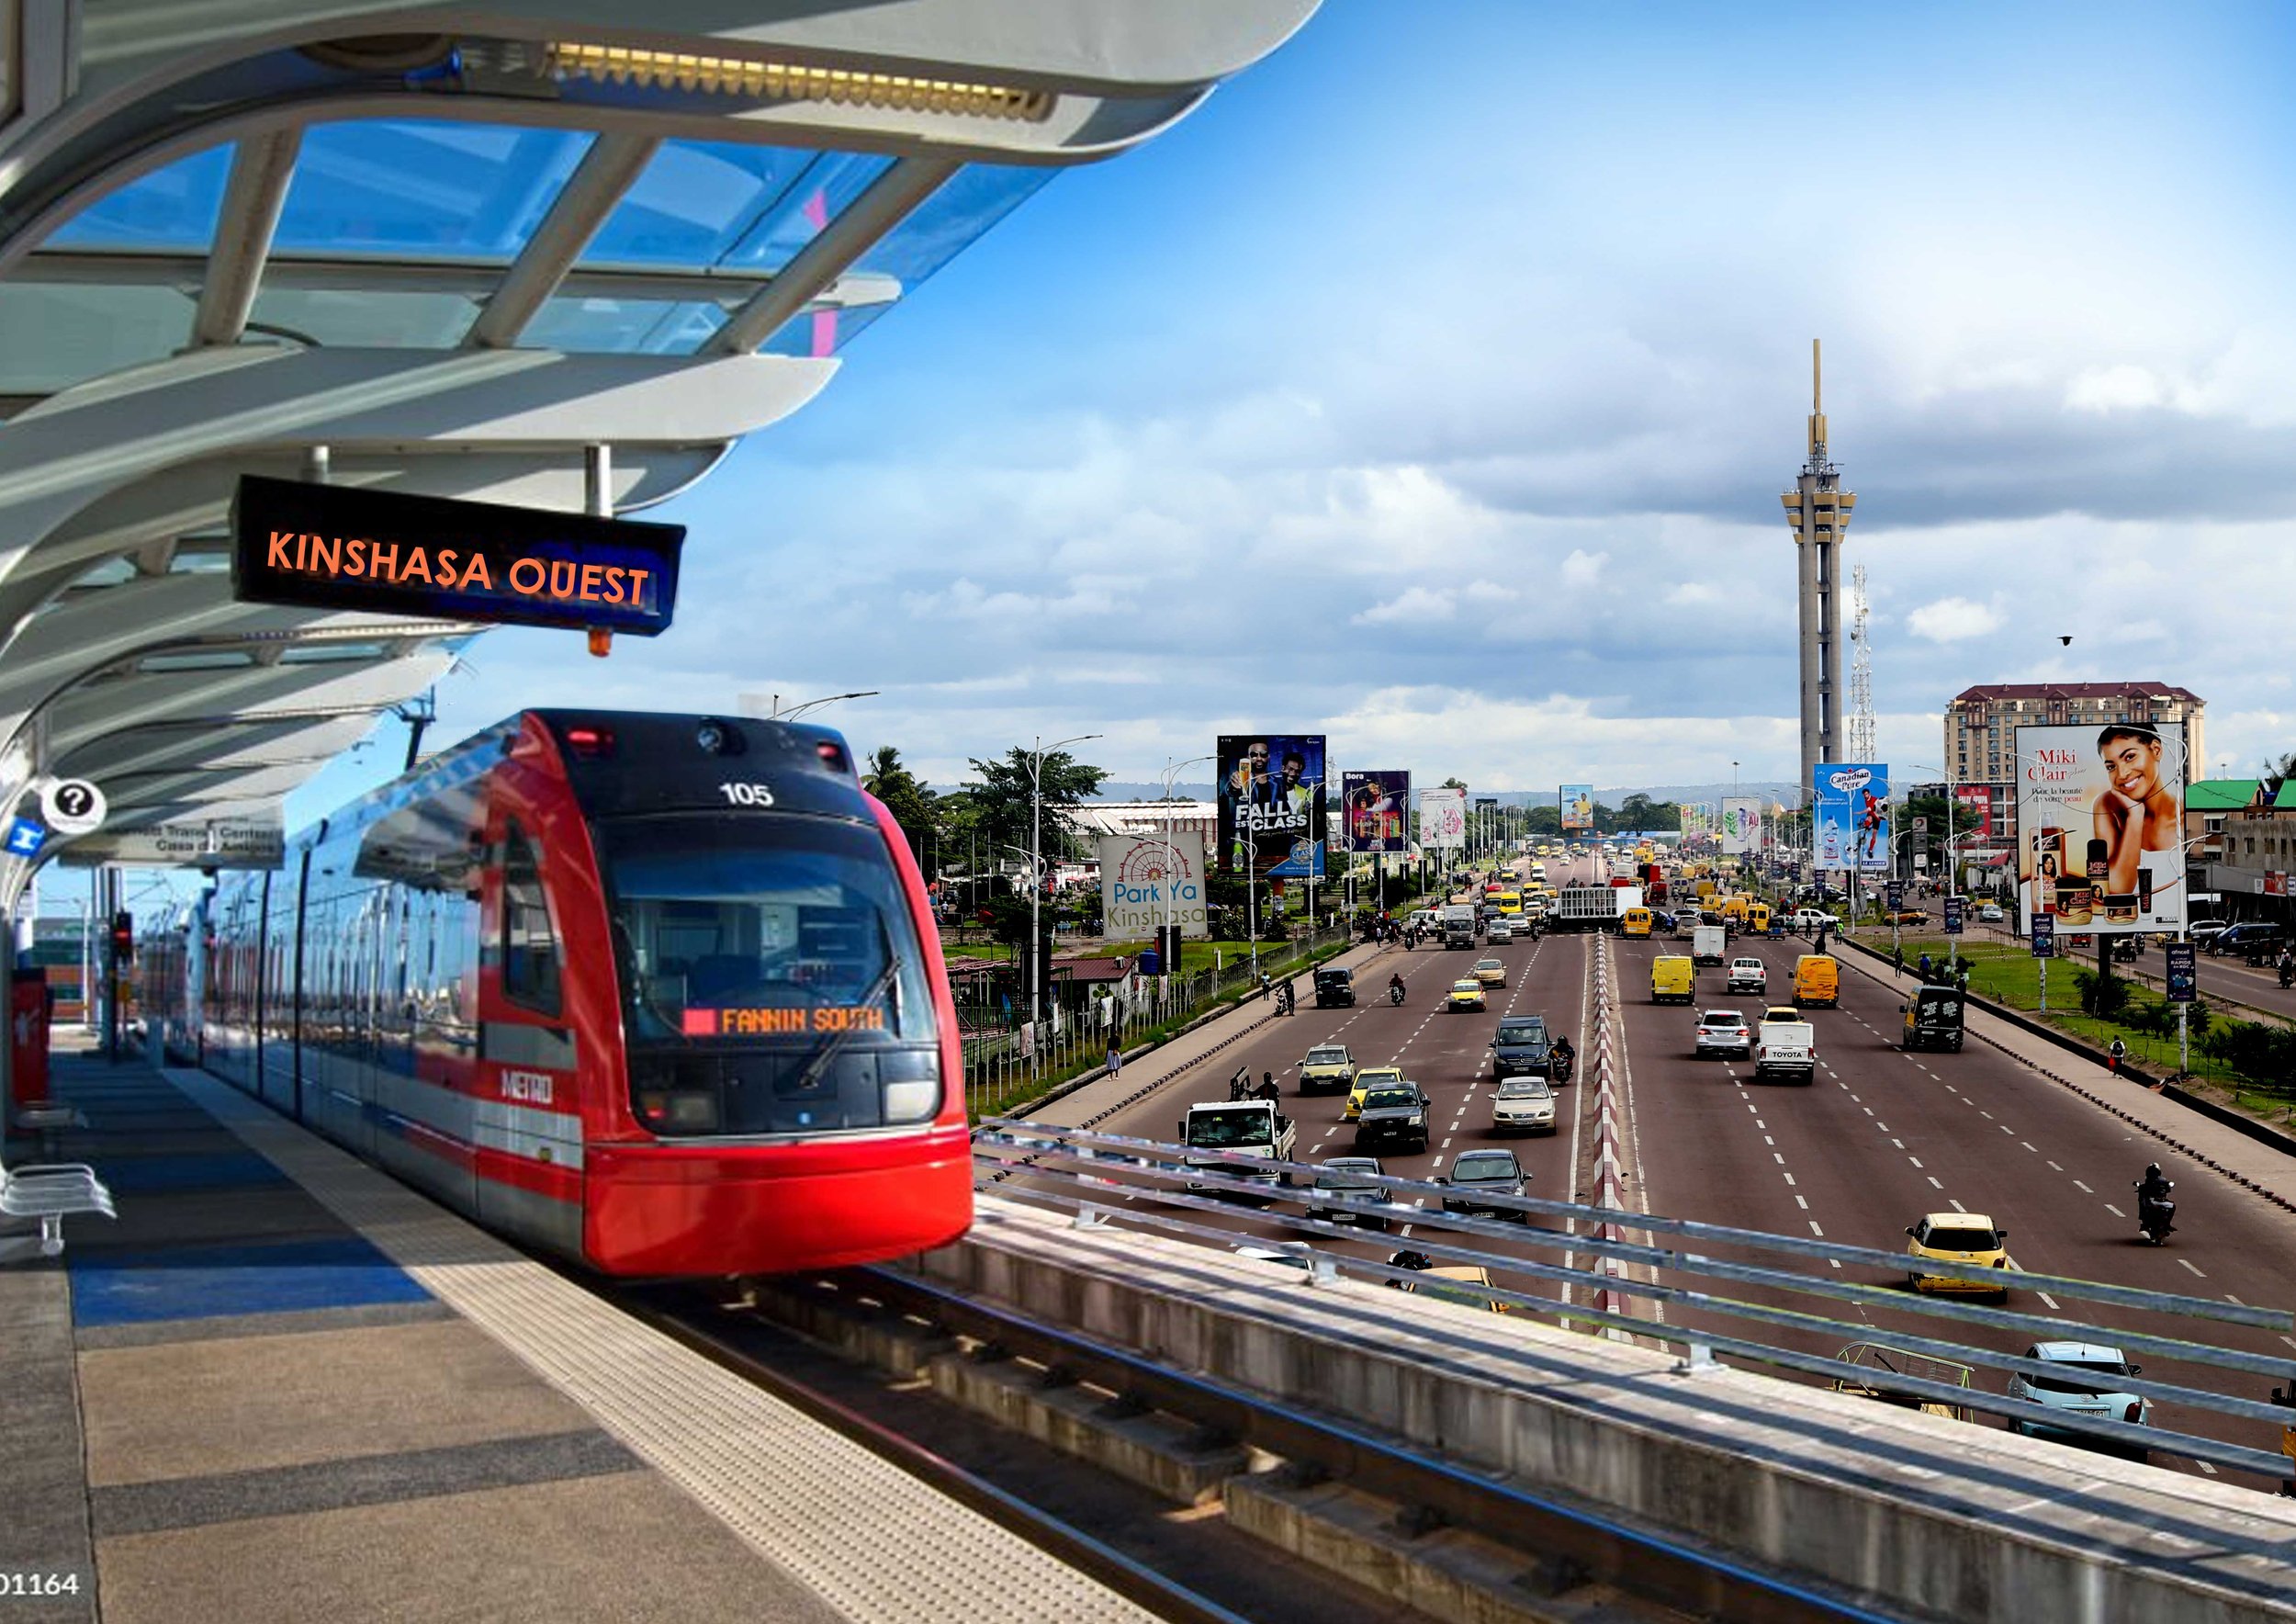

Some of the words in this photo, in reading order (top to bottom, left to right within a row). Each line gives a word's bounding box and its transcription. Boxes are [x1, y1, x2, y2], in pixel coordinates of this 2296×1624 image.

[267, 531, 492, 591] KINSHASA
[509, 558, 648, 606] OUEST
[2039, 749, 2077, 764] Miki
[1830, 771, 1870, 784] Canadian
[2027, 765, 2067, 781] Clair
[718, 782, 774, 806] 105
[2059, 786, 2083, 795] beauté
[1235, 799, 1304, 820] FALLY
[1252, 814, 1308, 831] CLASS
[155, 840, 194, 851] Casa
[1114, 883, 1161, 904] Park
[1169, 880, 1197, 901] Ya
[1107, 905, 1206, 928] Kinshasa
[722, 1009, 806, 1034] FANNIN
